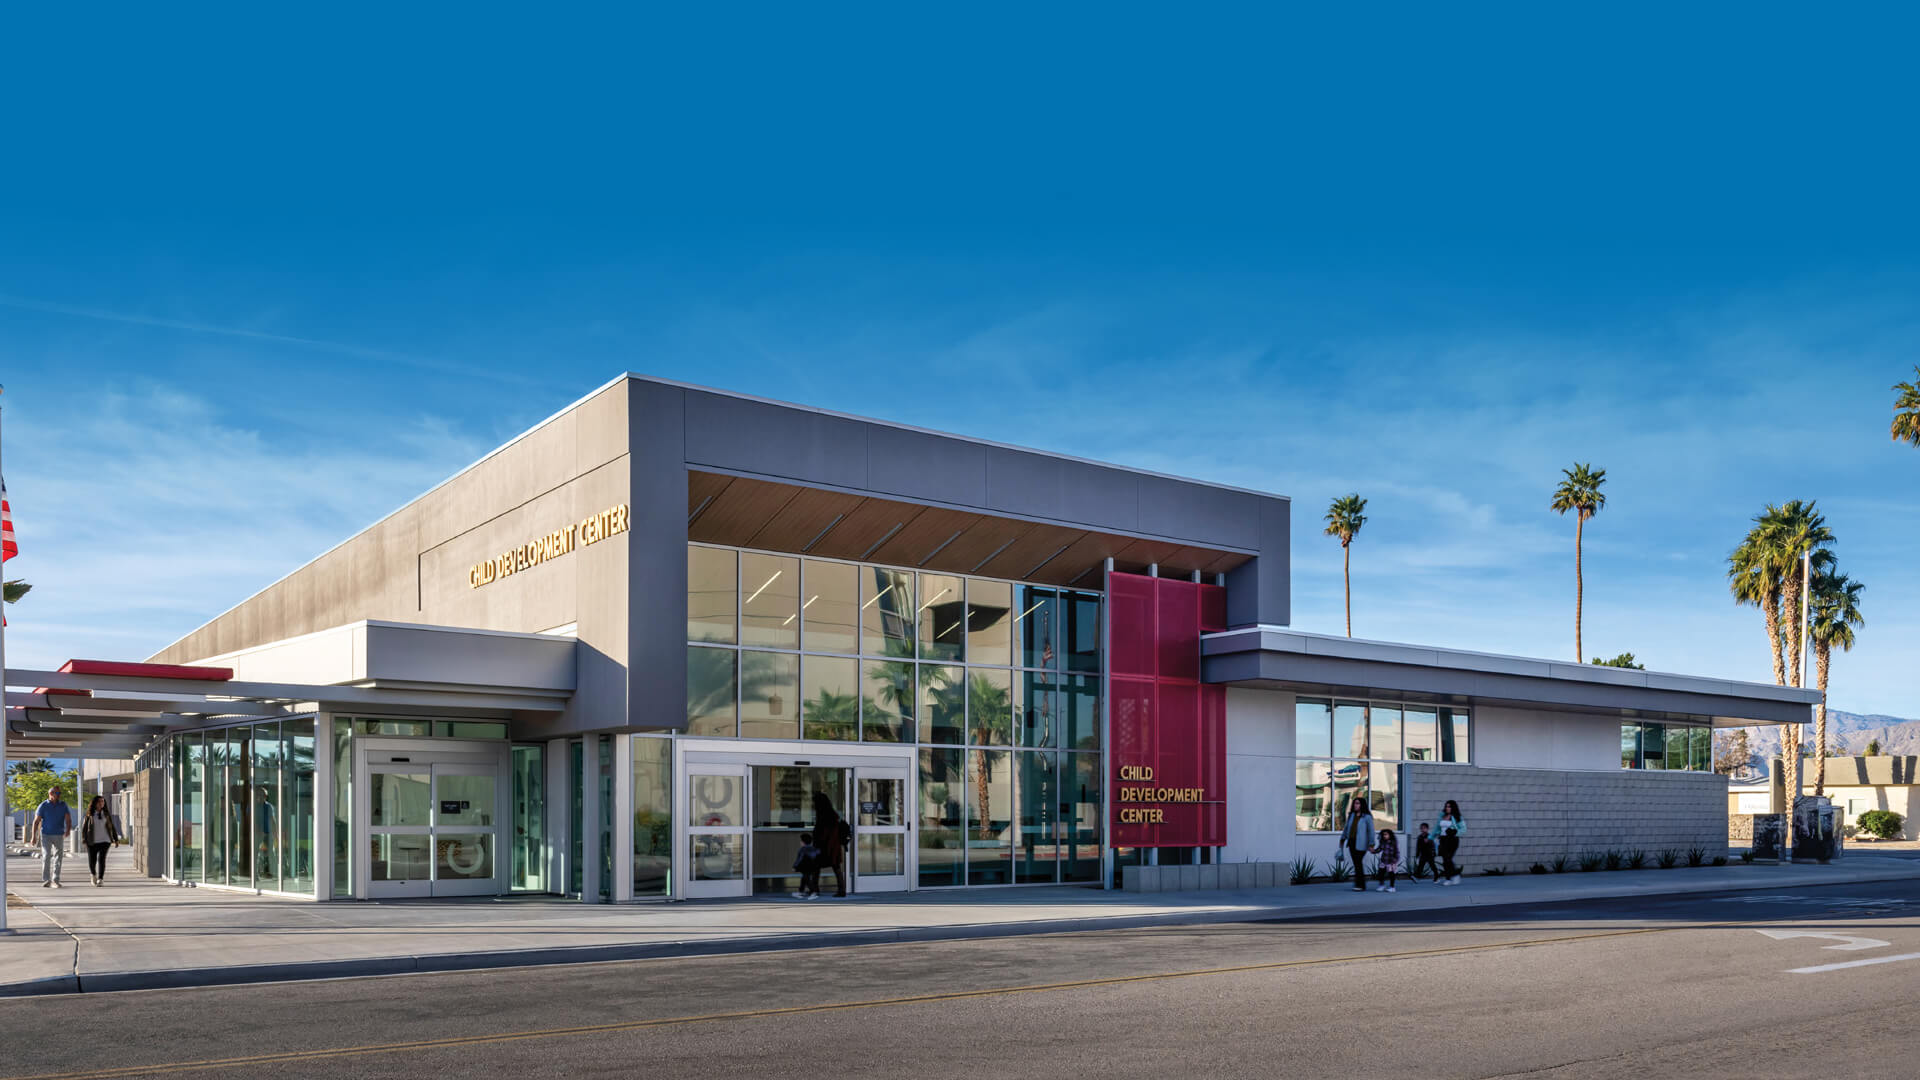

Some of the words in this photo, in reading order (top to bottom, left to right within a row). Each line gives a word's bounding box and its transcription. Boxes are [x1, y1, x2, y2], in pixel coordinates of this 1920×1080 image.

[469, 559, 496, 588] CHILD
[497, 524, 577, 579] DEVELOPMENT
[579, 504, 630, 546] CENTER
[1120, 765, 1154, 781] CHILD
[1120, 787, 1205, 802] DEVELOPMENT
[1120, 808, 1164, 823] CENTER
